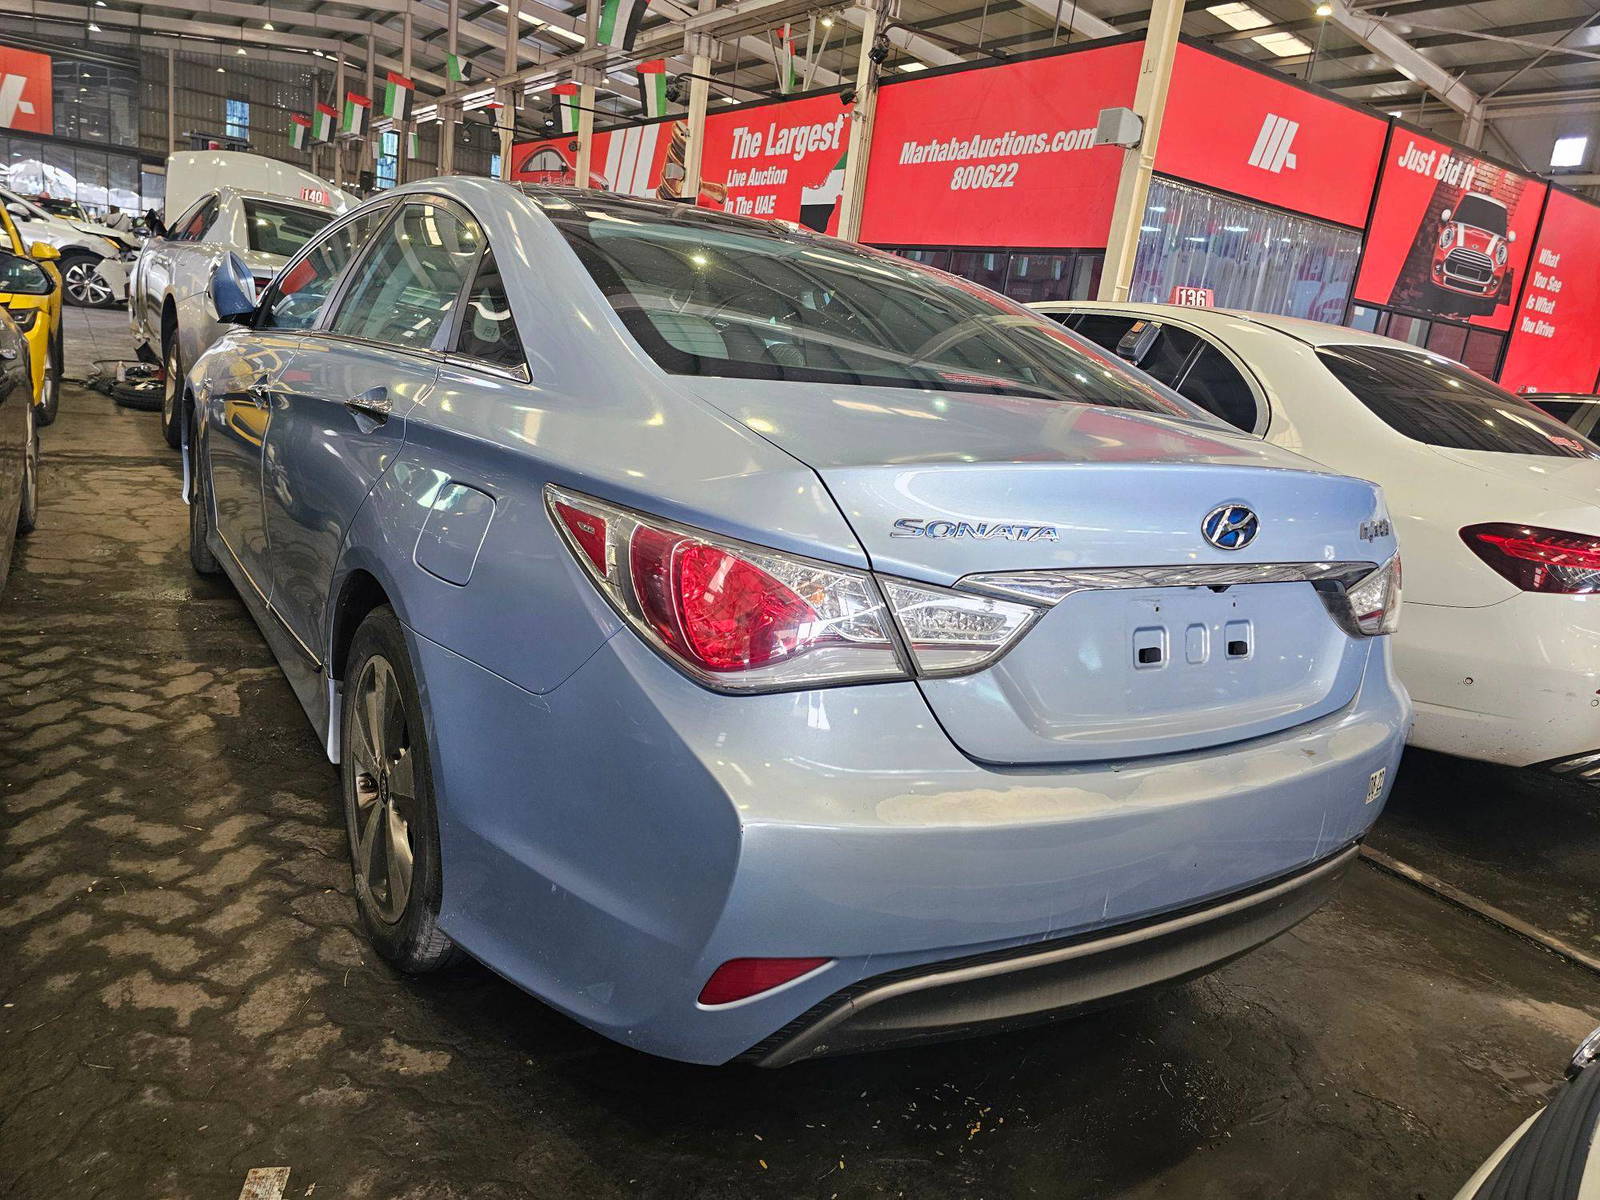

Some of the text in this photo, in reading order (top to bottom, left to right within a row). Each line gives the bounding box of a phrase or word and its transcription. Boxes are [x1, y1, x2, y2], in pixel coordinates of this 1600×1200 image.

[731, 113, 844, 161] The Largest
[899, 127, 1097, 164] MarhabaAuctions.com
[726, 166, 788, 187] Live Auction
[950, 162, 1019, 190] 800622
[1398, 141, 1475, 191] Just Bid It
[304, 189, 323, 203] 140
[723, 195, 777, 214] In The UAE
[1539, 248, 1560, 268] What
[1533, 271, 1562, 293] You See
[1180, 289, 1206, 307] 136
[1526, 294, 1556, 314] Is What
[1521, 316, 1555, 338] You Drive
[889, 518, 1060, 542] SONATA
